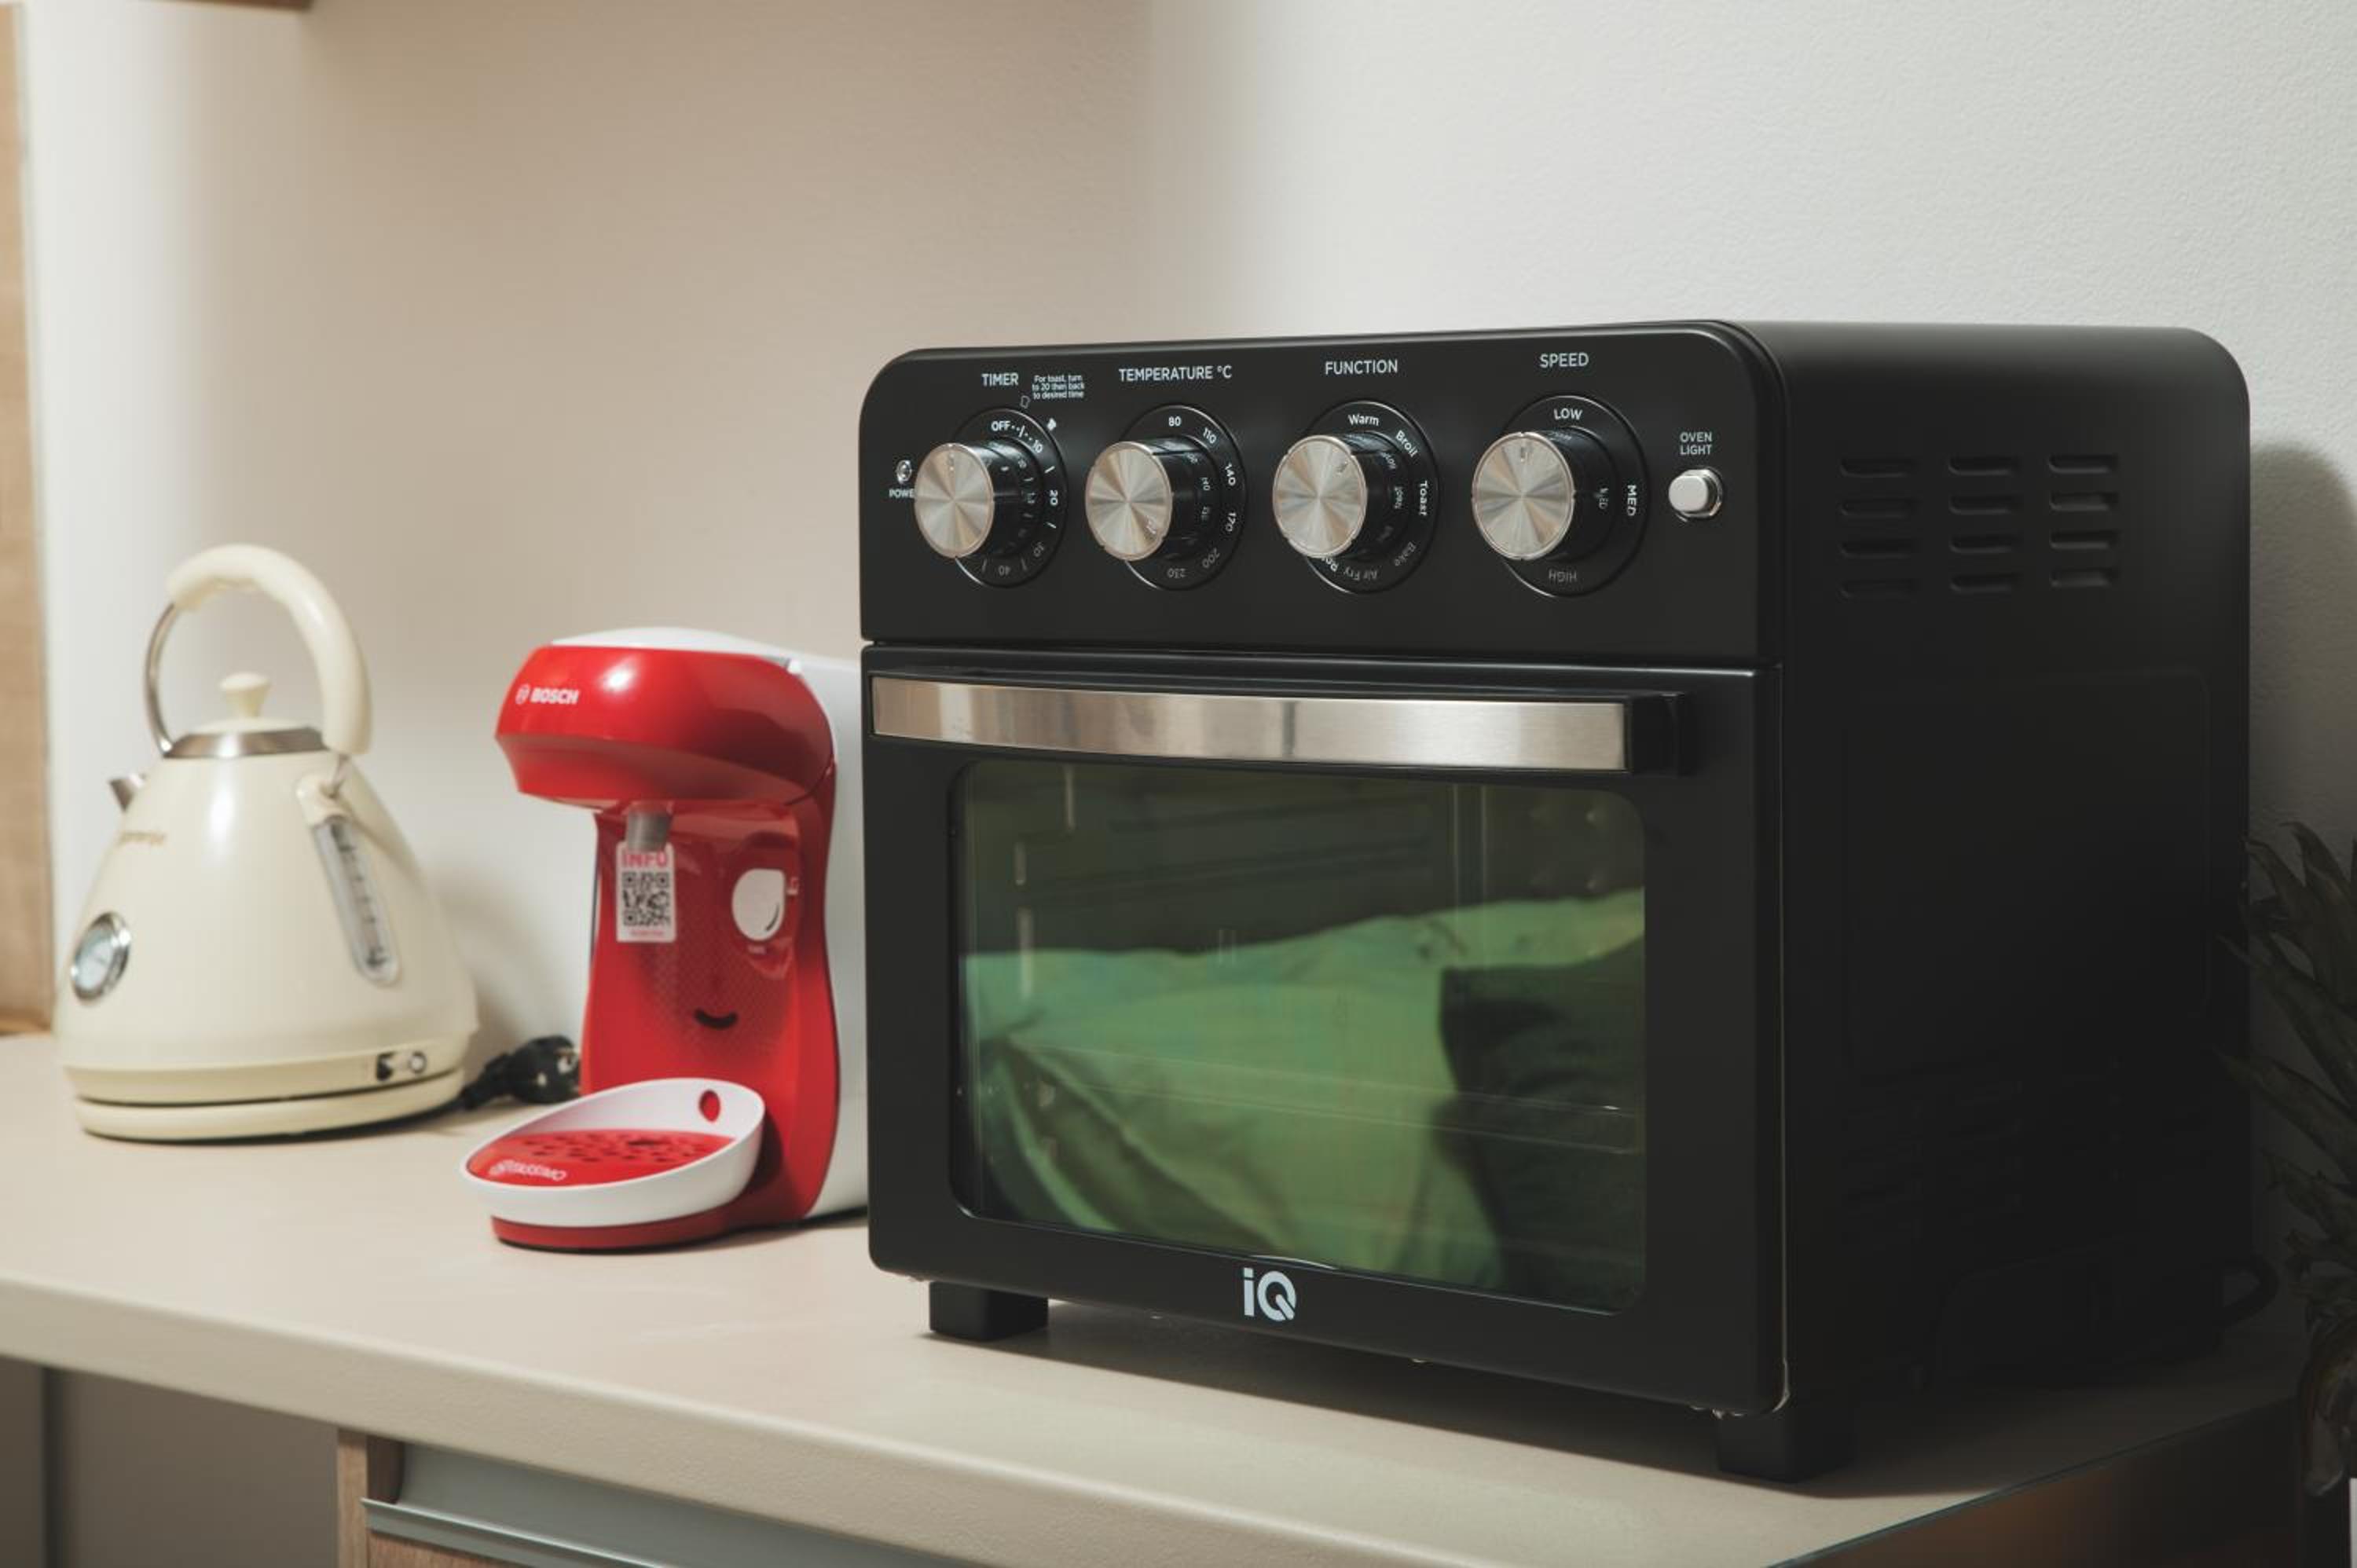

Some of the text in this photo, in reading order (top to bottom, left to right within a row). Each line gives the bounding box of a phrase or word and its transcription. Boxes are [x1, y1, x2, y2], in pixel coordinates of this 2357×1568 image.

[1325, 358, 1398, 375] FUNCTION
[1540, 352, 1589, 368] SPEED
[981, 372, 1019, 387] TIMER
[1119, 365, 1214, 382] TEMPERATURE
[1168, 416, 1182, 427] 80
[1347, 413, 1380, 427] Warm
[1553, 407, 1583, 420] LOW
[991, 420, 1011, 431] OFF
[1203, 427, 1217, 444] 110
[1395, 430, 1419, 457] Broil
[1679, 431, 1713, 443] OVEN
[1032, 438, 1043, 453] 10
[1680, 444, 1712, 456] LIGHT
[1225, 462, 1237, 486] 140
[889, 488, 915, 498] POWE
[1050, 489, 1058, 506] 20
[1419, 480, 1428, 515] Toast
[1626, 484, 1637, 516] MED
[1225, 512, 1237, 533] 170
[998, 565, 1011, 576] 40
[1548, 568, 1578, 583] HIGH
[530, 687, 580, 705] BOSCH
[1244, 1266, 1297, 1322] iQ
